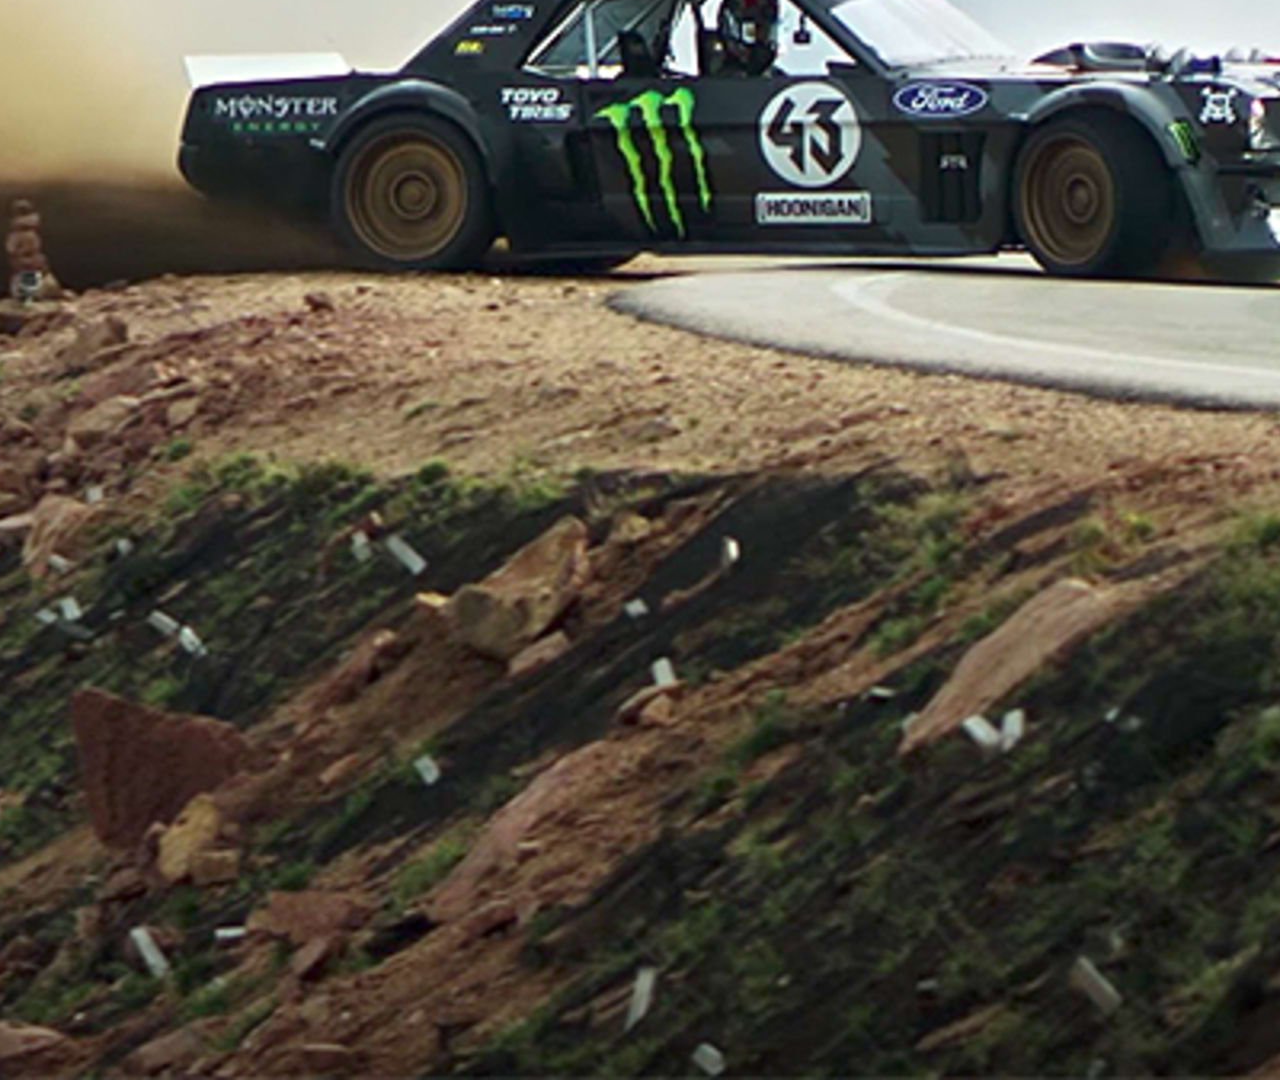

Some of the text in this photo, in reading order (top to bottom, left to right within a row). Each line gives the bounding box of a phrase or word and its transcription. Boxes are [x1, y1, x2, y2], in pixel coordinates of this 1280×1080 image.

[501, 87, 559, 104] TOYO
[911, 85, 970, 111] Ford
[215, 94, 338, 119] MONSTER
[510, 103, 573, 120] TIRES
[231, 121, 319, 132] ENERGY
[767, 97, 845, 175] 43
